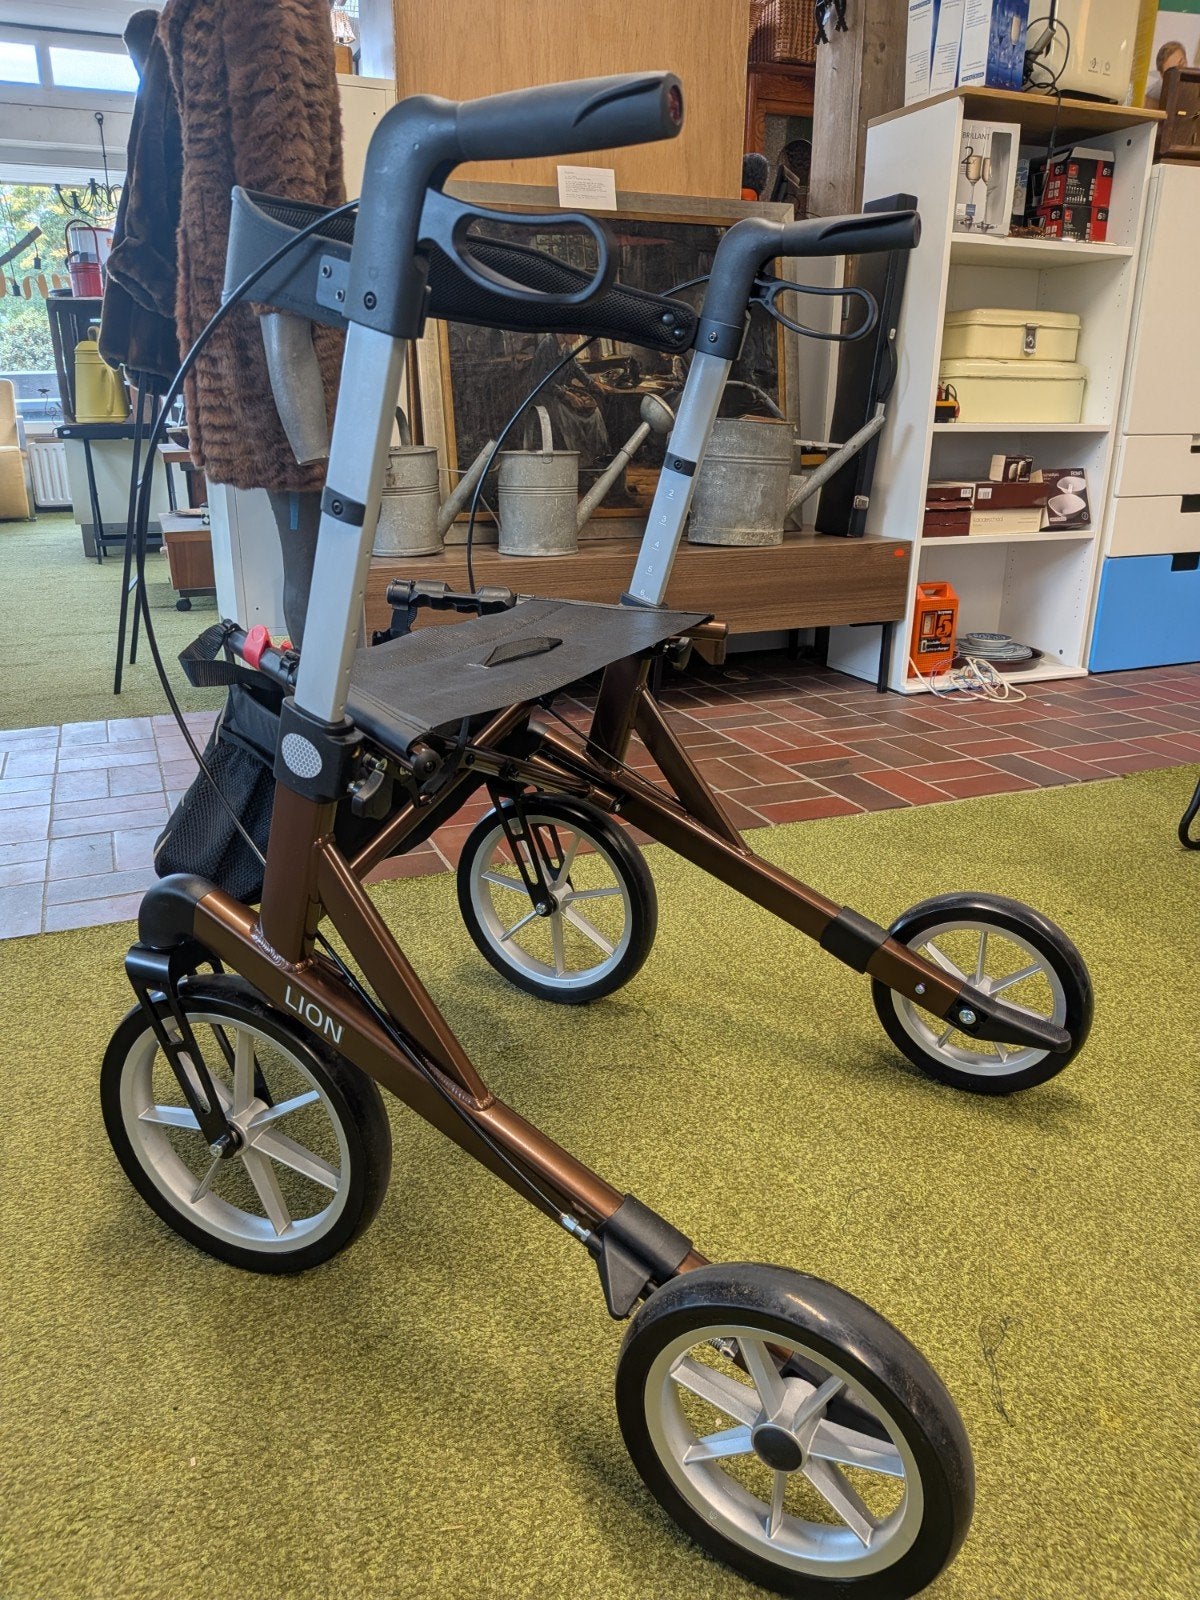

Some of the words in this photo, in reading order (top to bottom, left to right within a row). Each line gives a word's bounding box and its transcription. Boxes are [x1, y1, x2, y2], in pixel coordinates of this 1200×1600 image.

[961, 146, 974, 165] 2
[668, 489, 675, 497] 2
[661, 515, 667, 523] 3
[647, 565, 653, 573] 5
[936, 614, 952, 637] 5
[284, 985, 343, 1044] LION
